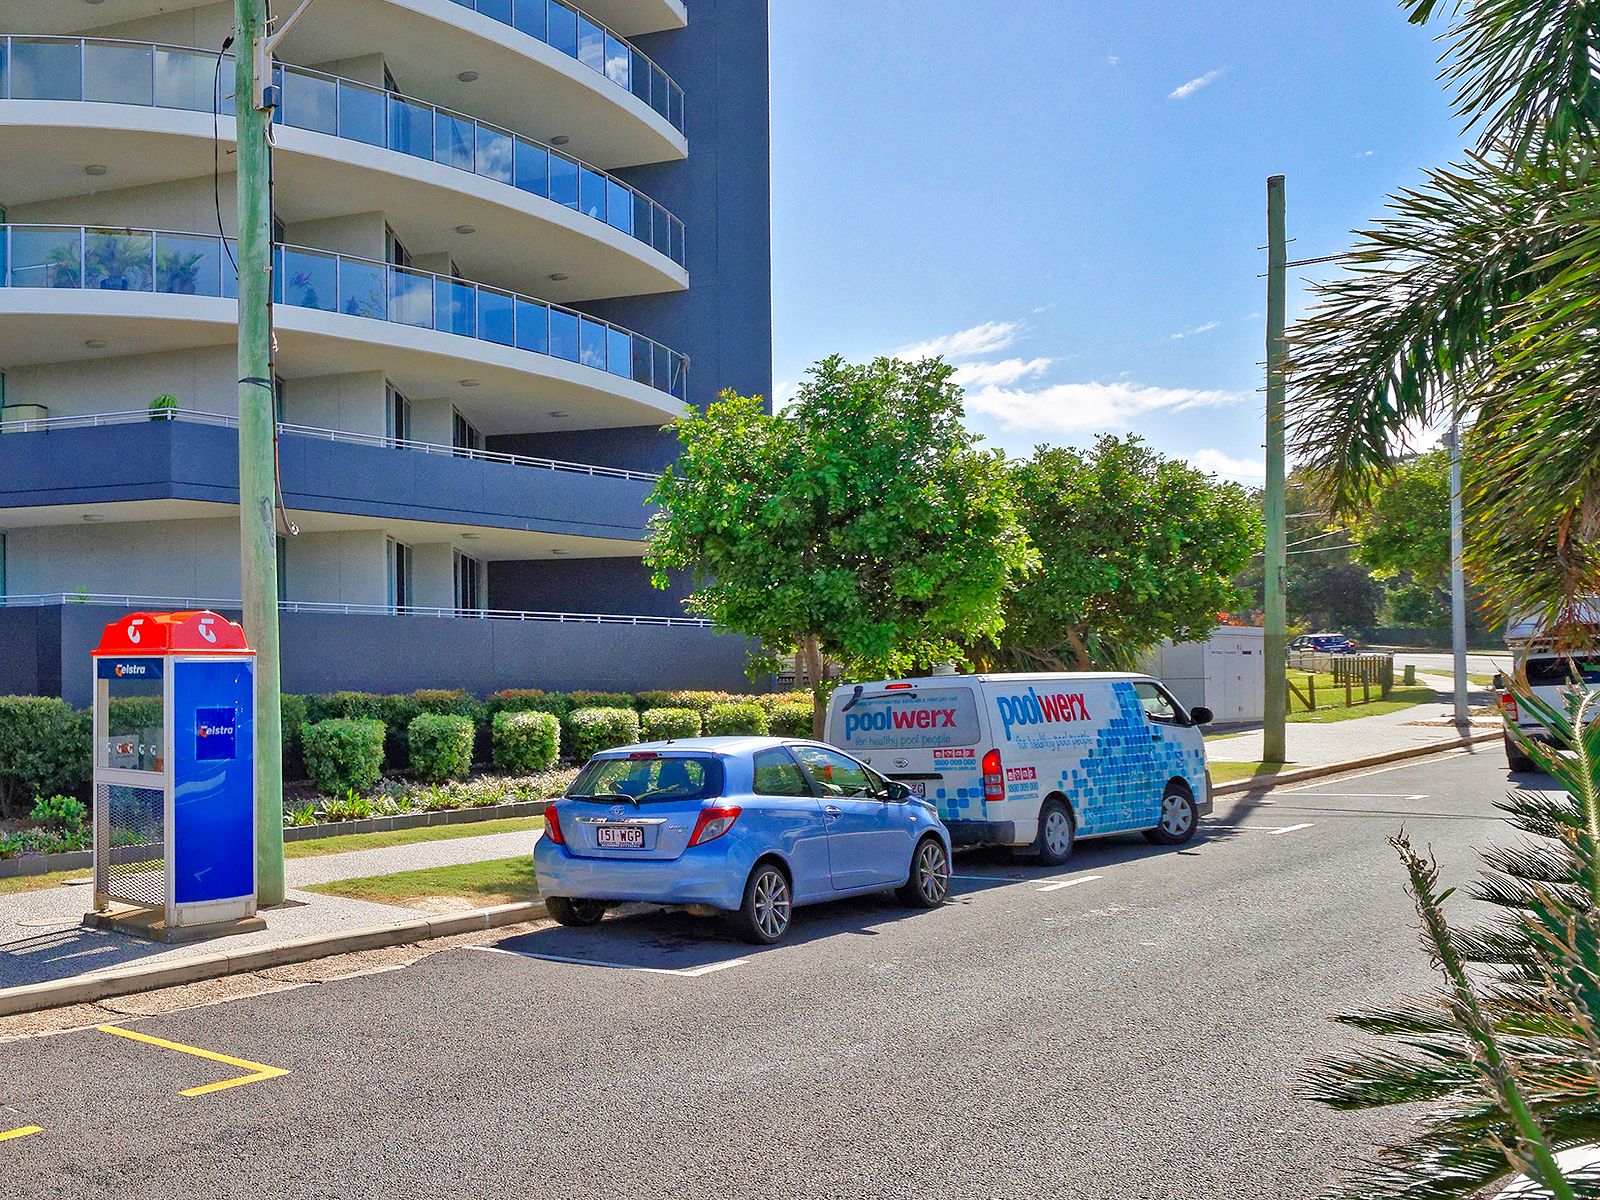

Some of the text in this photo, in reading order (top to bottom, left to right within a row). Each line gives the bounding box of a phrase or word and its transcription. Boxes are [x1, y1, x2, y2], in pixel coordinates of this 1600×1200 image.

[115, 664, 145, 677] Telstra
[996, 686, 1092, 741] poolwerx
[845, 706, 957, 740] poolwerx
[198, 726, 233, 738] Telstra
[901, 734, 919, 746] pool
